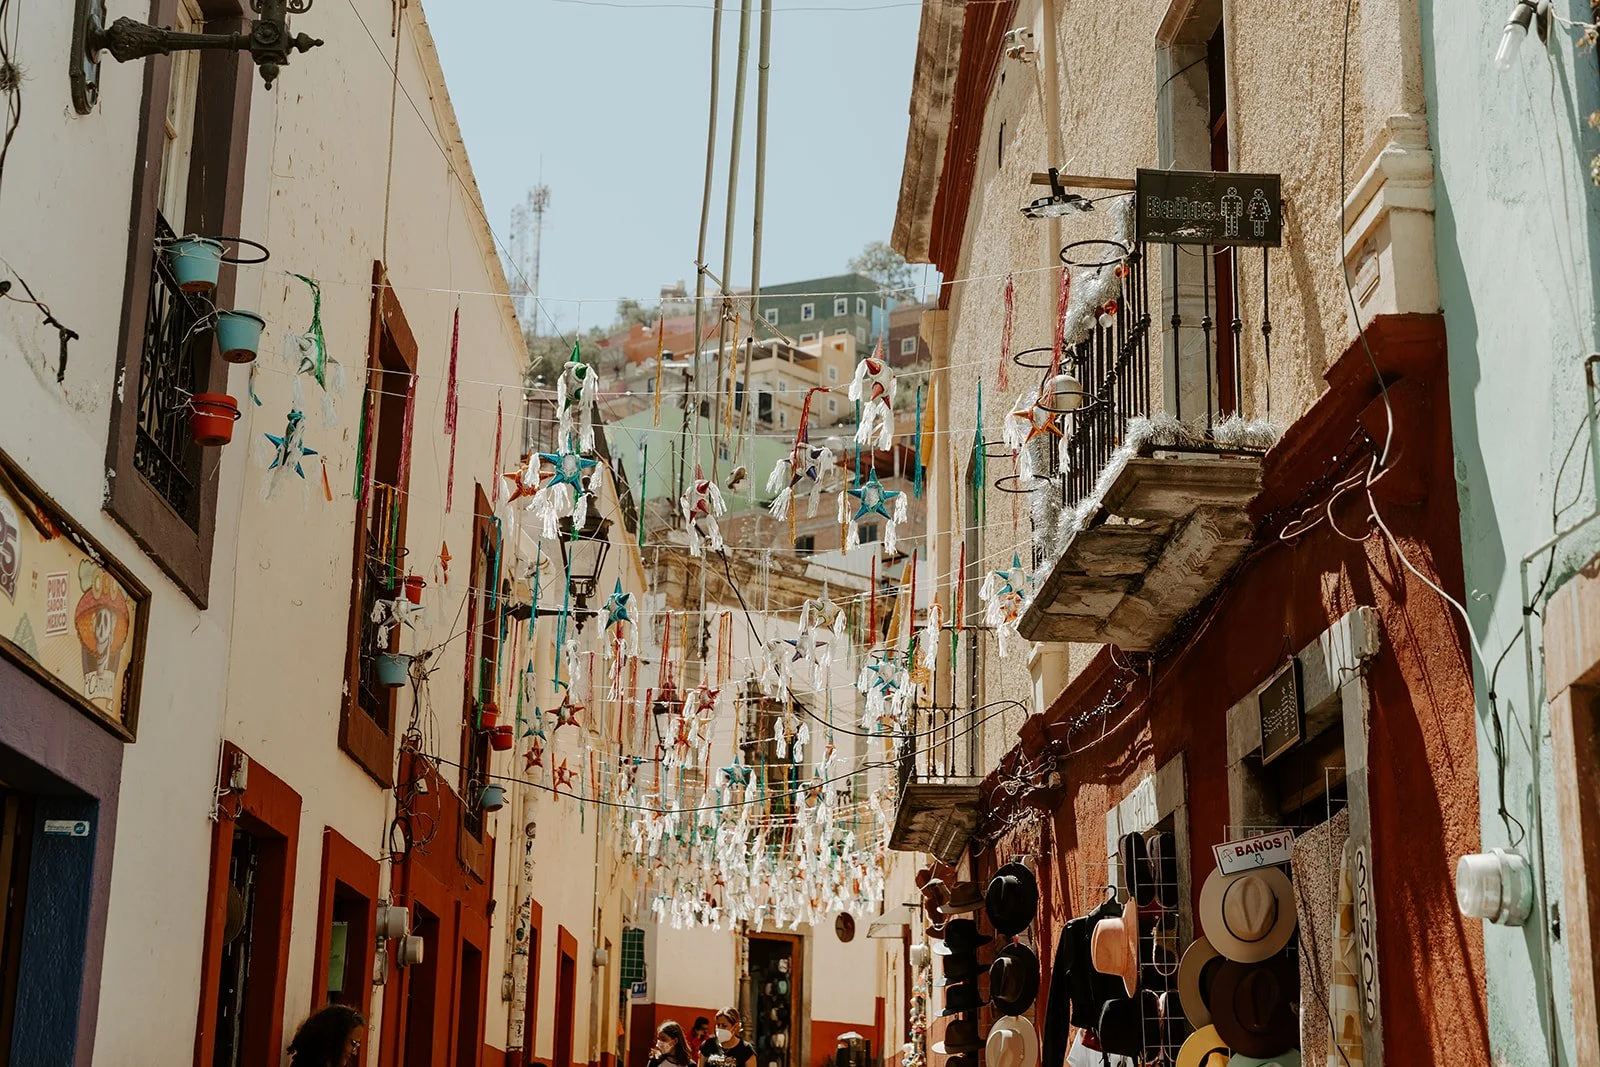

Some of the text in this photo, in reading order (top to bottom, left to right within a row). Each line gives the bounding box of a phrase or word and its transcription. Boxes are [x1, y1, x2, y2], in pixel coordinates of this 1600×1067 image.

[1146, 195, 1216, 221] Baños
[48, 578, 67, 599] PURO
[1234, 837, 1282, 857] BAÑOS
